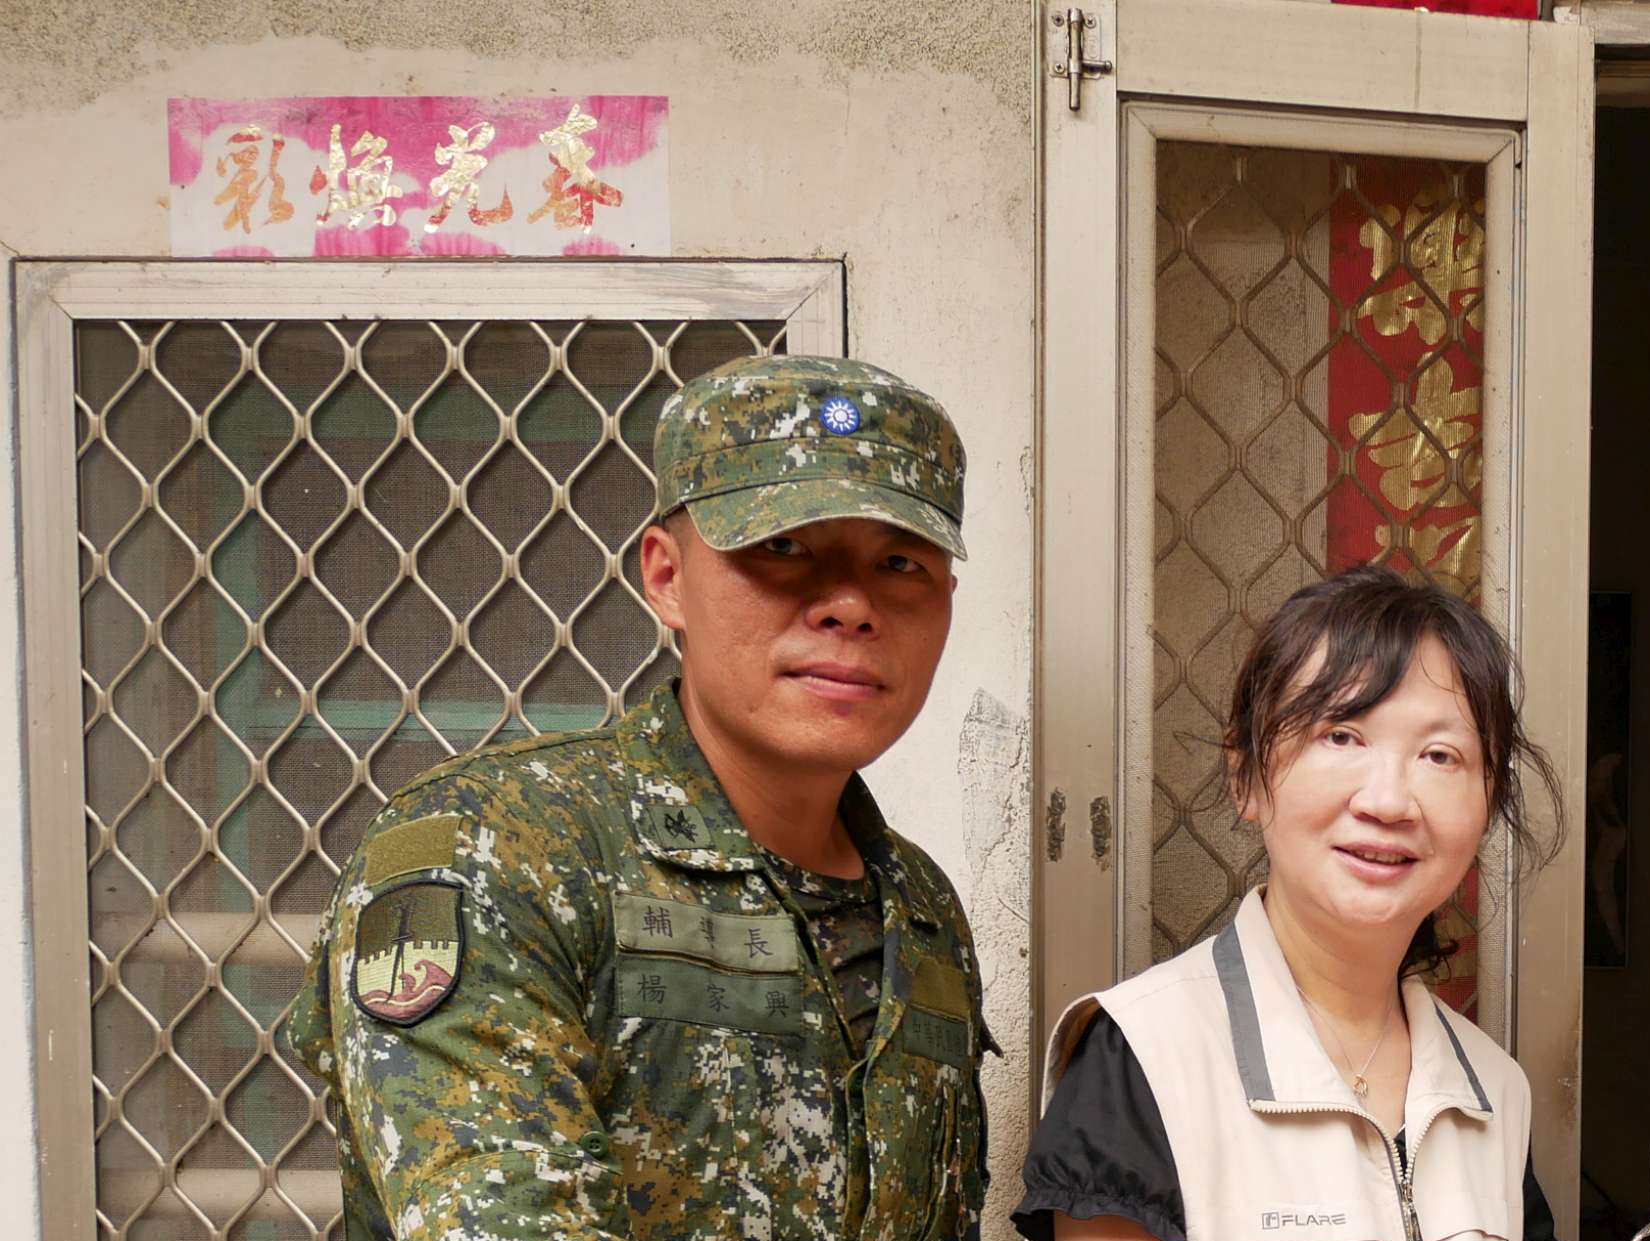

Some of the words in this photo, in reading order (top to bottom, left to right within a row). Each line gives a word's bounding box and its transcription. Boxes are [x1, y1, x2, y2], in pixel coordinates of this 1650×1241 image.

[637, 973, 790, 1019] 楊家興
[1281, 1213, 1347, 1227] FLARE
